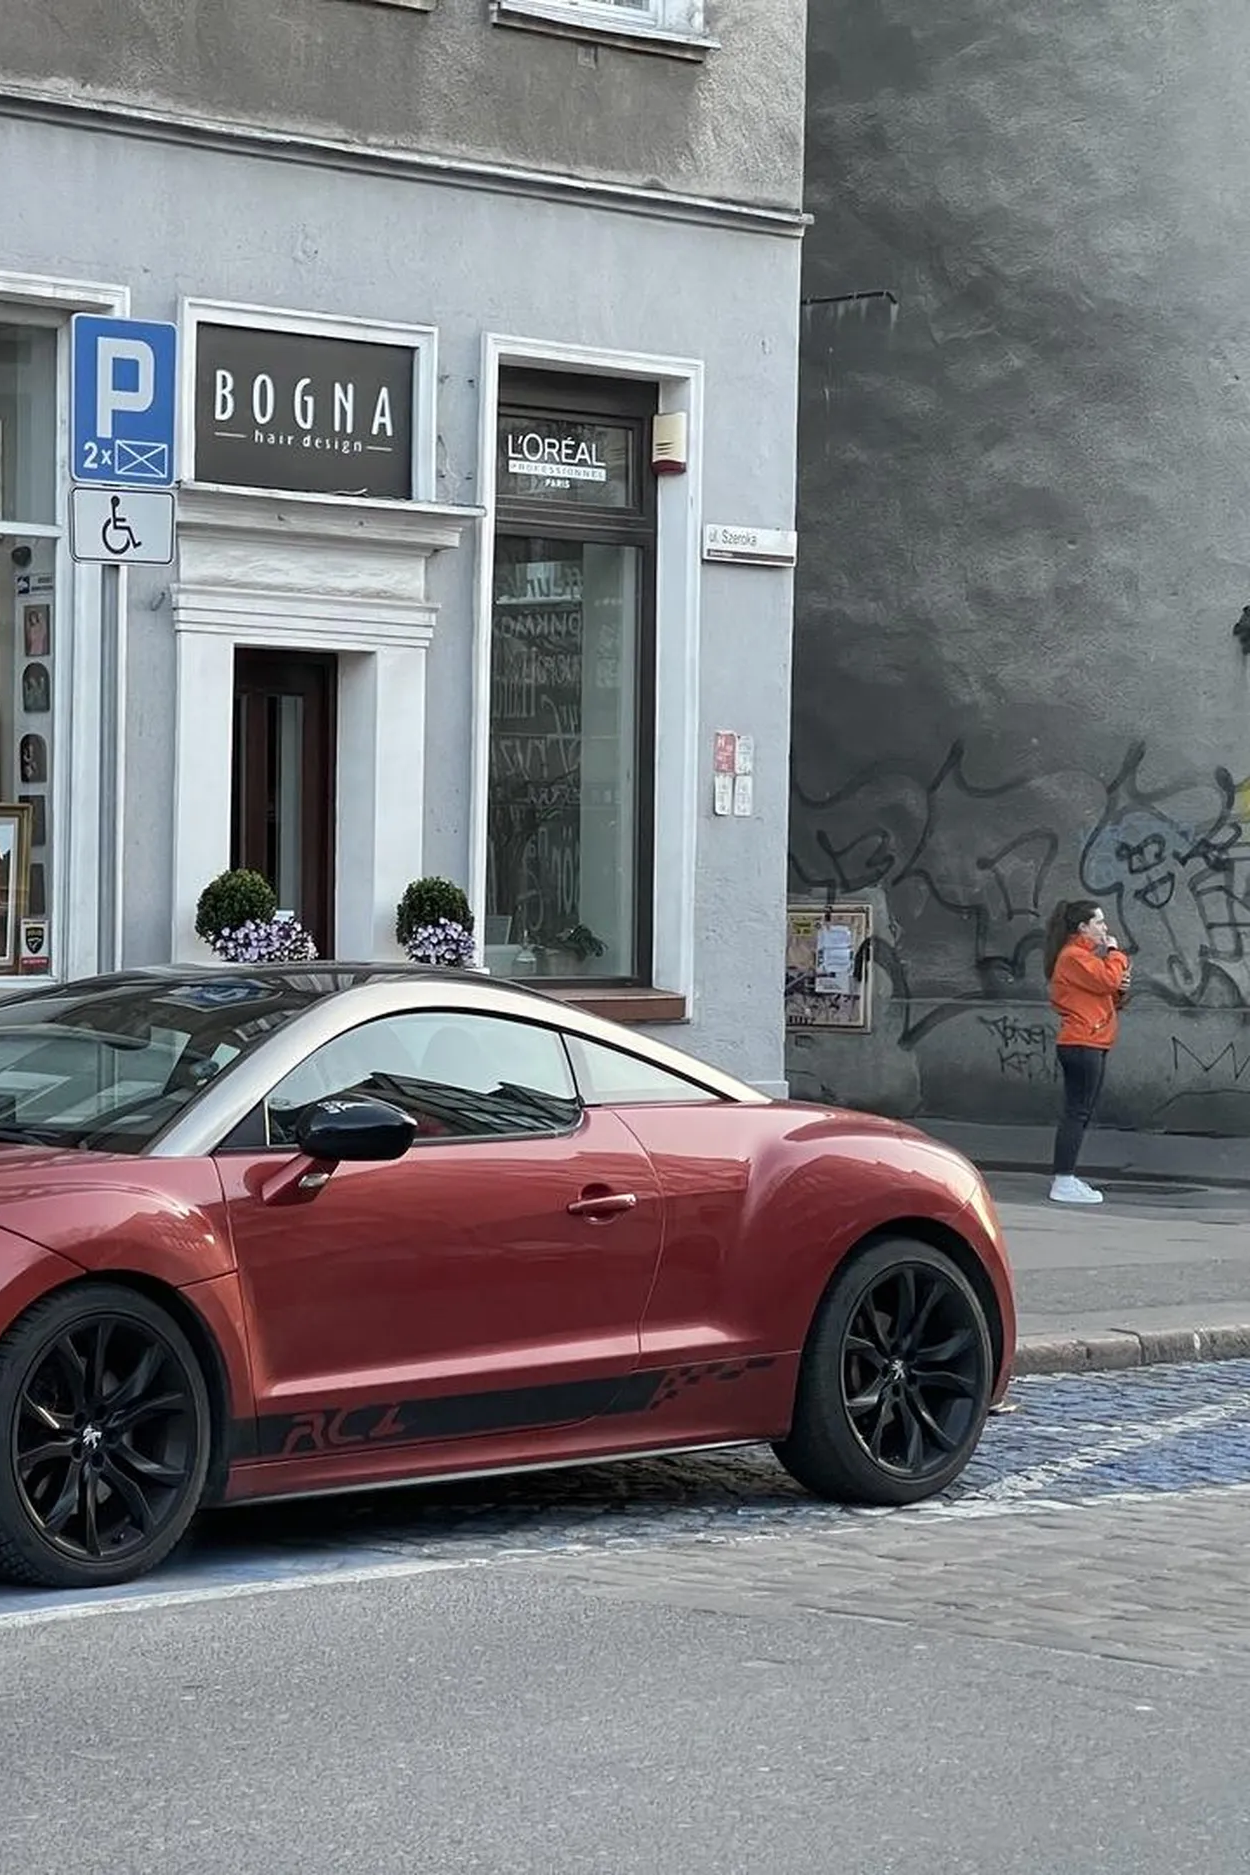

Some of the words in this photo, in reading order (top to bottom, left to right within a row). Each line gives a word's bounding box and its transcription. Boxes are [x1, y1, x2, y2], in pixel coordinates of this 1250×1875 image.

[97, 337, 154, 438] P
[214, 369, 393, 437] BOGNA
[254, 429, 295, 445] hair
[302, 434, 362, 454] design
